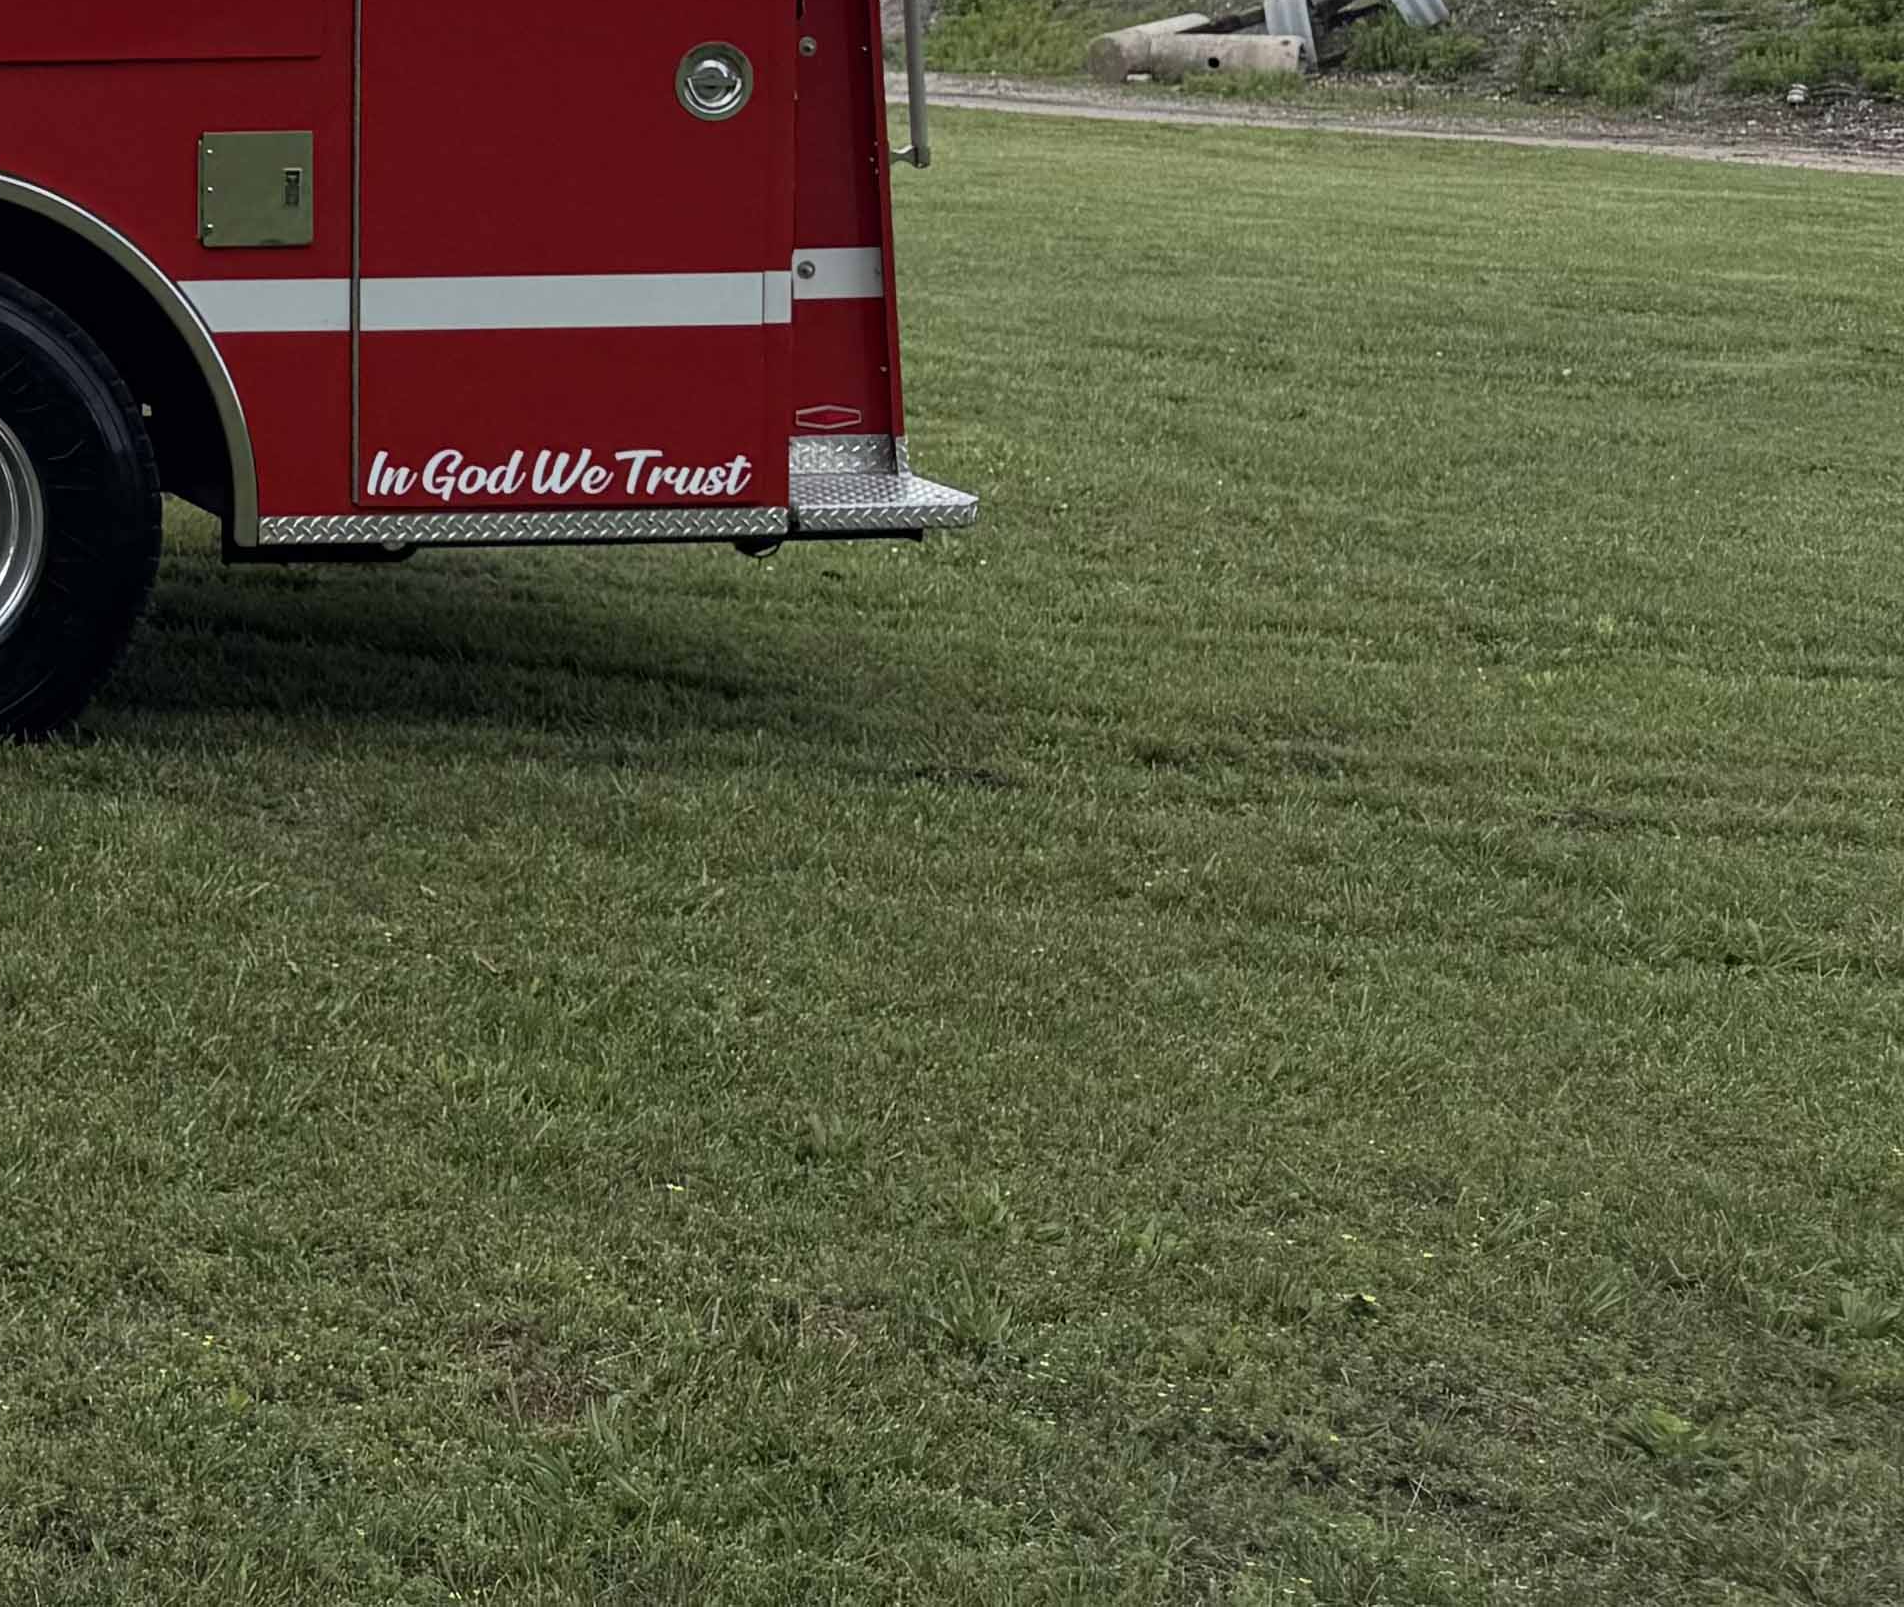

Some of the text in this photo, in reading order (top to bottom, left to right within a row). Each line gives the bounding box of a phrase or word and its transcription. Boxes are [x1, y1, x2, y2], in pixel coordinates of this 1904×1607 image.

[366, 448, 752, 501] In God We Trust
